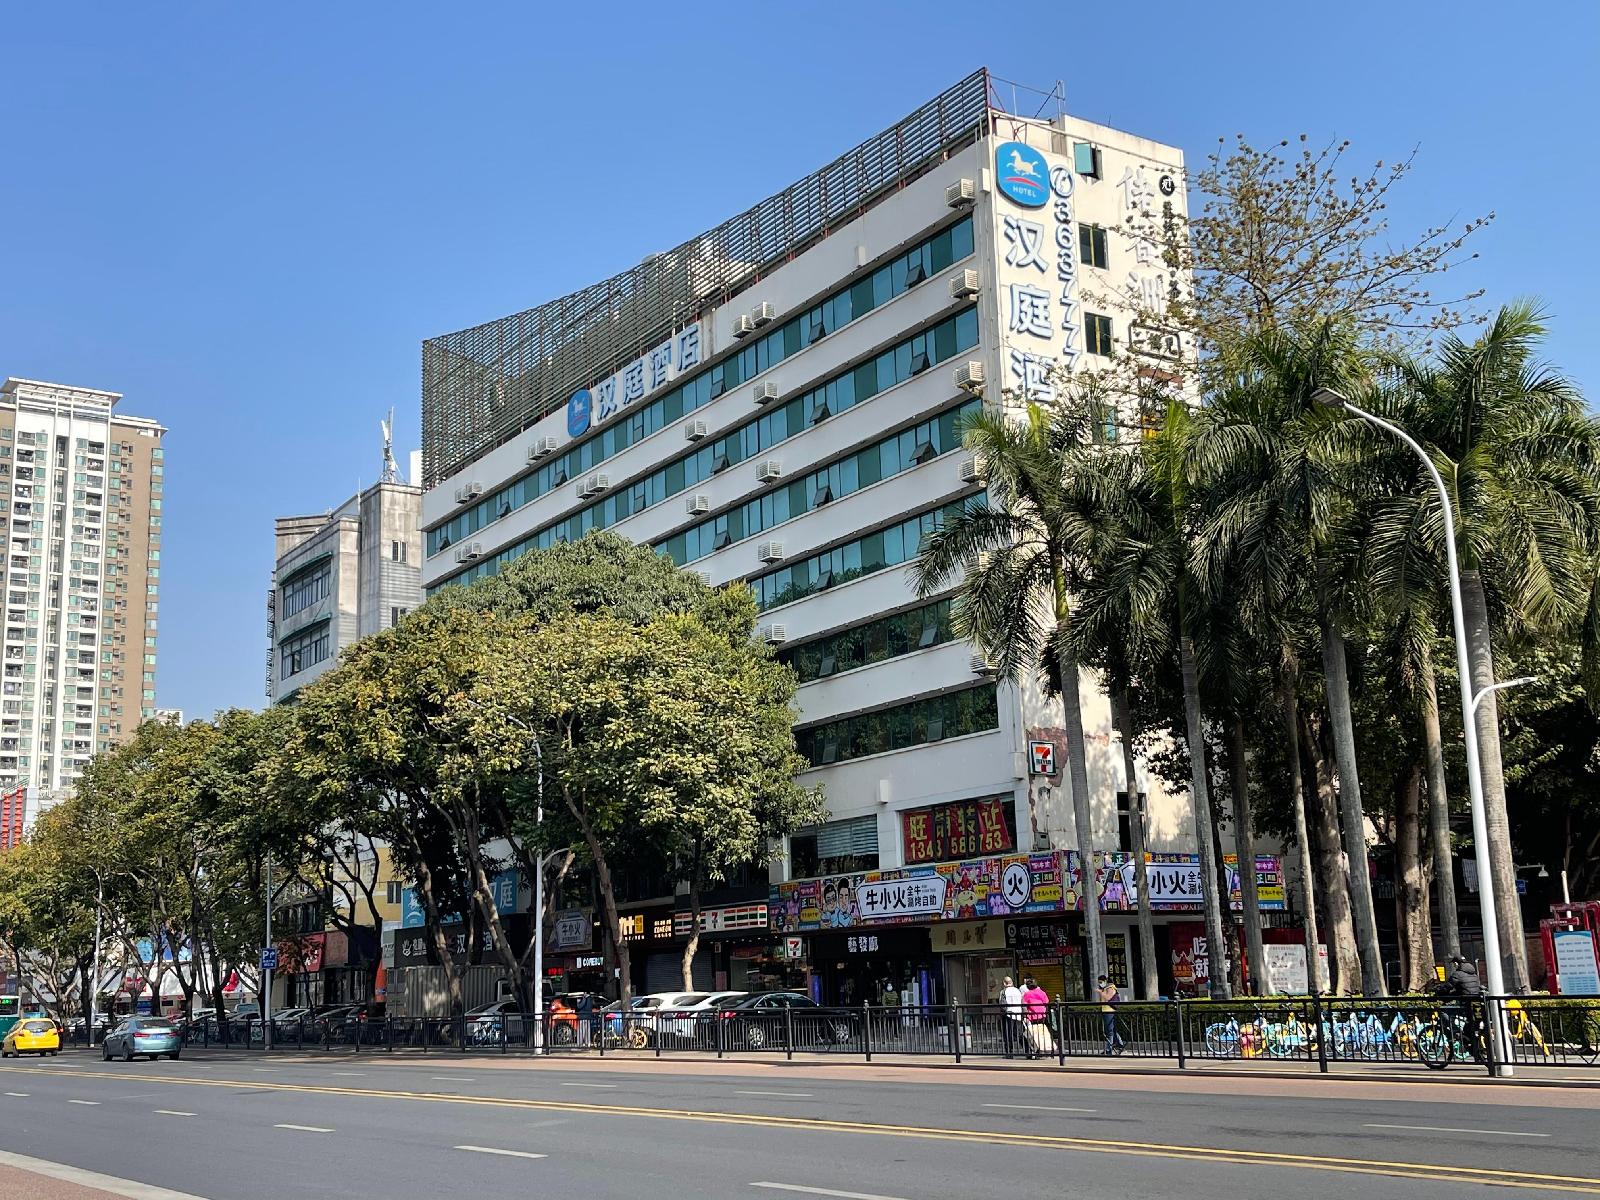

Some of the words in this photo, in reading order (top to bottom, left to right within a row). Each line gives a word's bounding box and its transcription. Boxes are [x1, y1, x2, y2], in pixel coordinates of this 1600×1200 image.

[1012, 186, 1037, 198] HOTEL
[597, 323, 699, 421] 汉庭酒店
[907, 885, 922, 896] 全牛
[1008, 873, 1024, 897] 火
[866, 886, 907, 911] 牛小火
[262, 950, 270, 960] P
[1193, 936, 1209, 956] 吃
